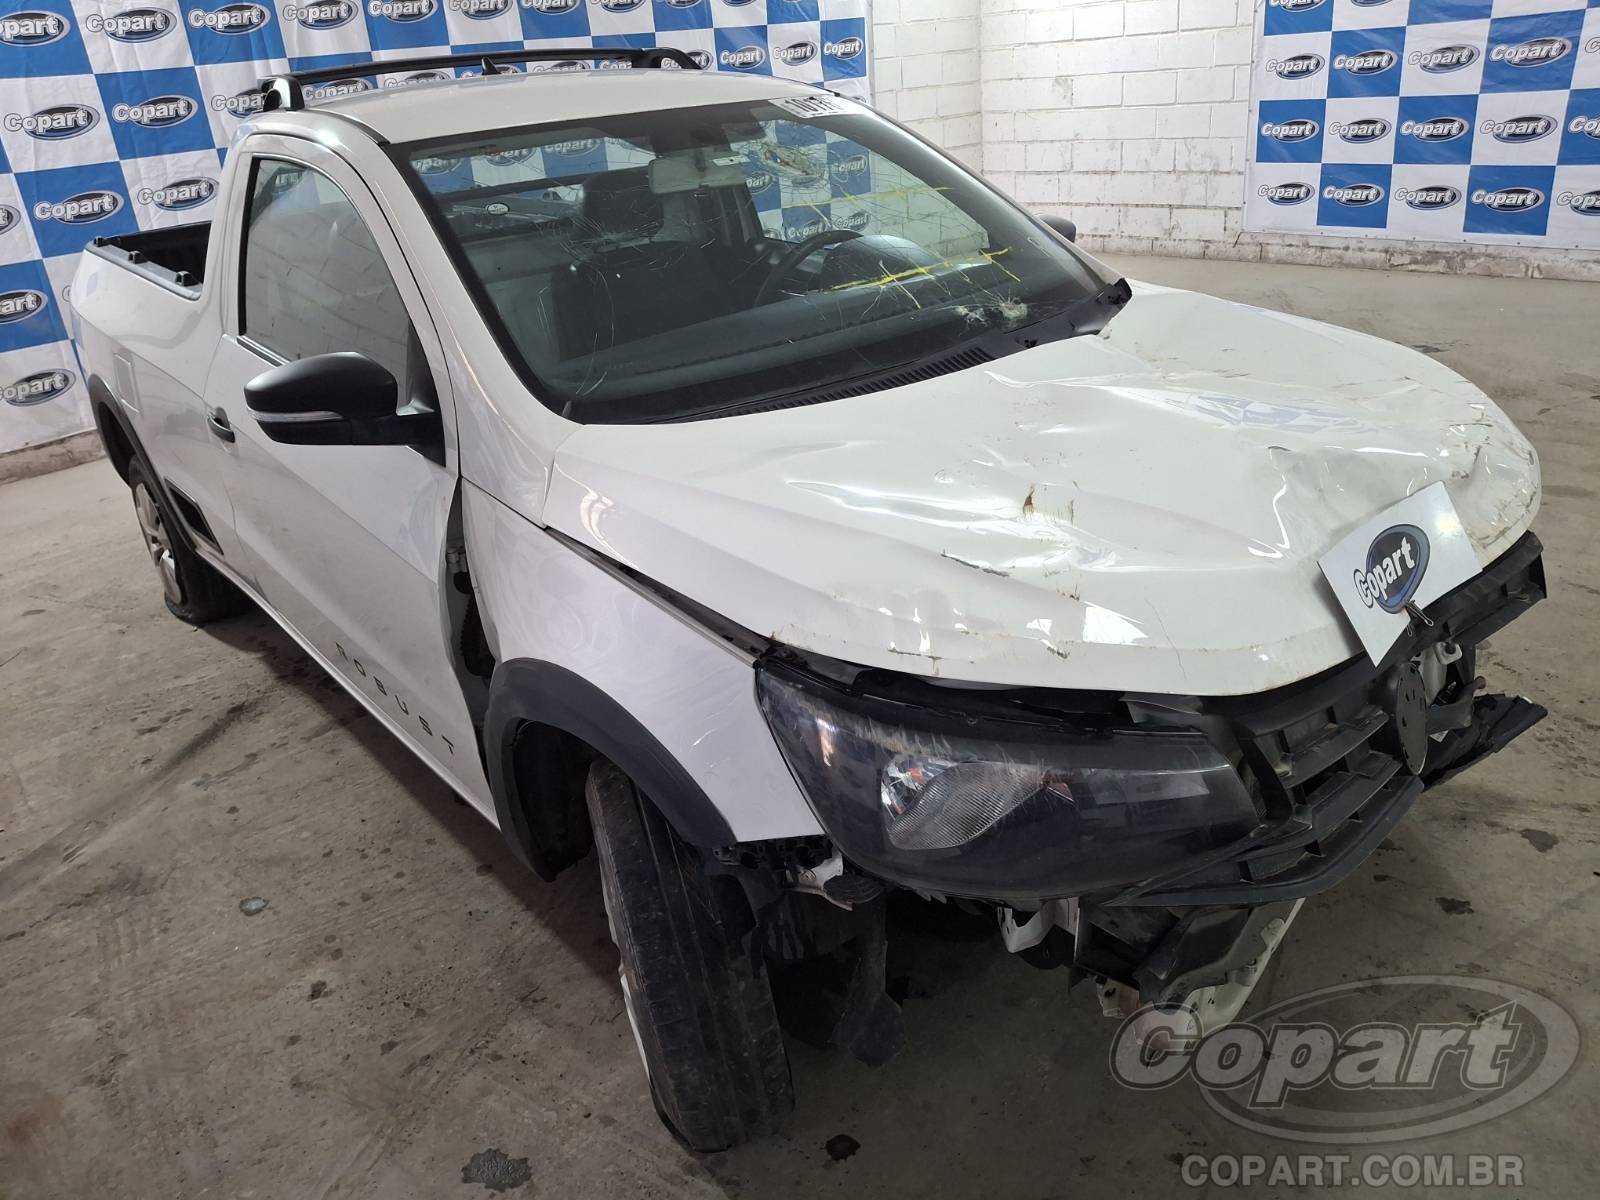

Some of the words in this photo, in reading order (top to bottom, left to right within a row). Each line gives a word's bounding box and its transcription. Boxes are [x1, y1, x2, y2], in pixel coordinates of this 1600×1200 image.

[188, 6, 262, 30] Copart
[283, 1, 348, 22] Copart
[368, 0, 430, 19] Copart
[0, 16, 59, 40] part
[86, 12, 166, 35] Copart
[773, 44, 812, 60] Copart
[824, 40, 861, 56] Copart
[1408, 47, 1471, 66] Copart
[1489, 40, 1563, 63] Copart
[720, 51, 761, 66] Copart
[1266, 57, 1318, 74] Copart
[1334, 53, 1391, 70] Copart
[112, 98, 188, 124] Copart
[211, 93, 267, 112] Copa
[4, 109, 88, 133] Copart
[1261, 122, 1312, 138] Copart
[1329, 121, 1384, 137] Copart
[1400, 120, 1463, 137] Copart
[1480, 118, 1547, 137] Copart
[137, 180, 210, 206] Copart
[1258, 184, 1307, 200] Copart
[1323, 186, 1378, 202] Copart
[1395, 188, 1454, 204] Copart
[1472, 189, 1535, 207] Copart
[34, 193, 114, 221] Copart
[1354, 536, 1416, 608] Copart
[335, 642, 455, 755] ROBUST
